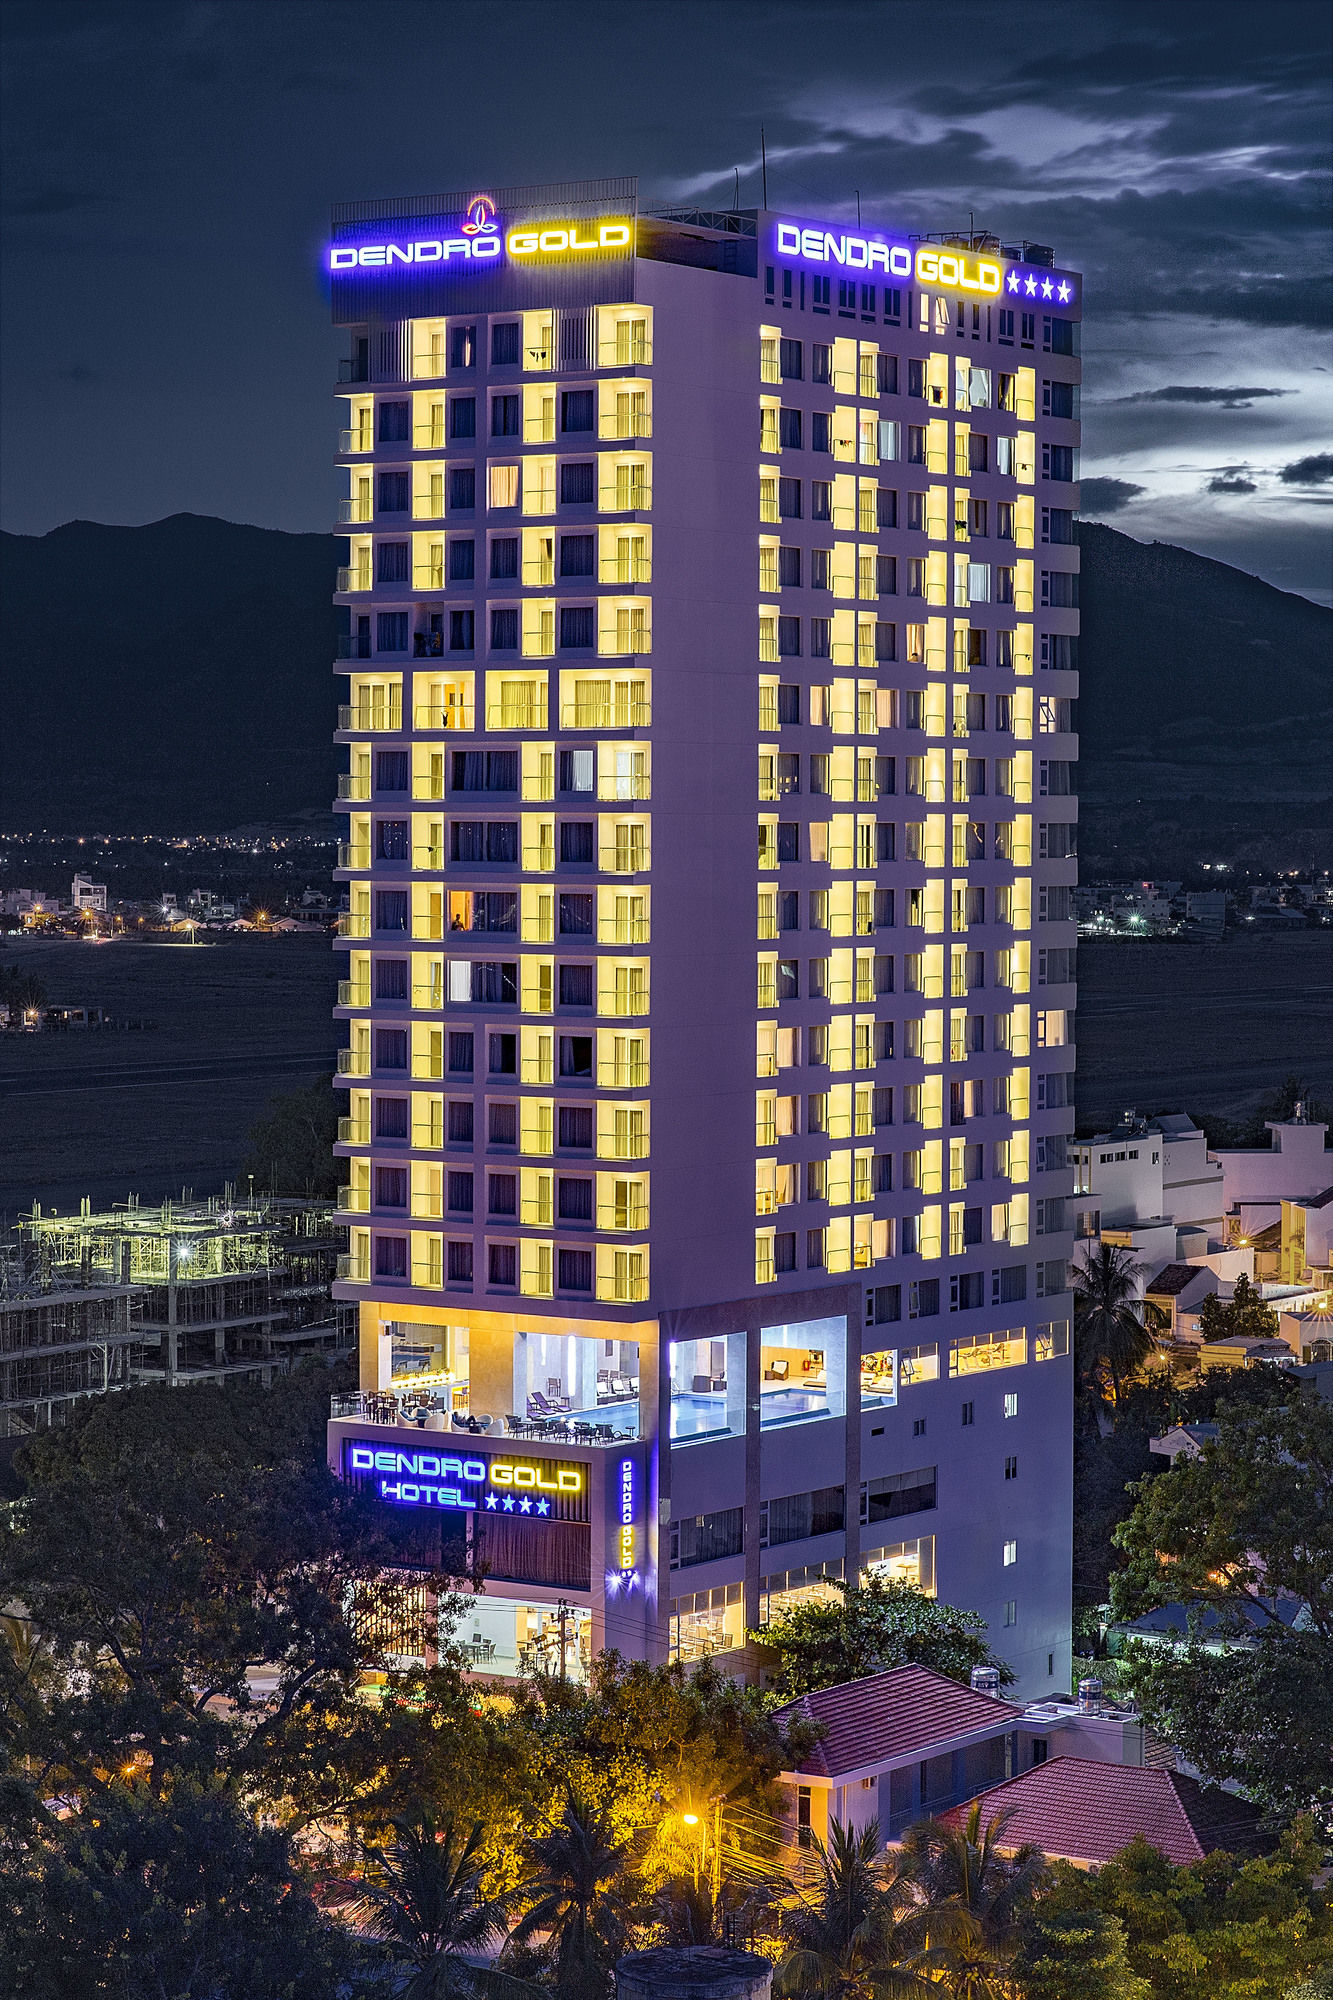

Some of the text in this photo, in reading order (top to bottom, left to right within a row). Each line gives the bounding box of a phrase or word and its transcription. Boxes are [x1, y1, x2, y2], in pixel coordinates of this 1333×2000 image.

[330, 225, 630, 269] DENDRO GOLD
[777, 223, 1001, 293] DENDRO GOLD
[352, 1448, 581, 1490] DENDRO GOLD
[382, 1481, 476, 1507] HOTEL
[622, 1461, 632, 1524] DENDRO
